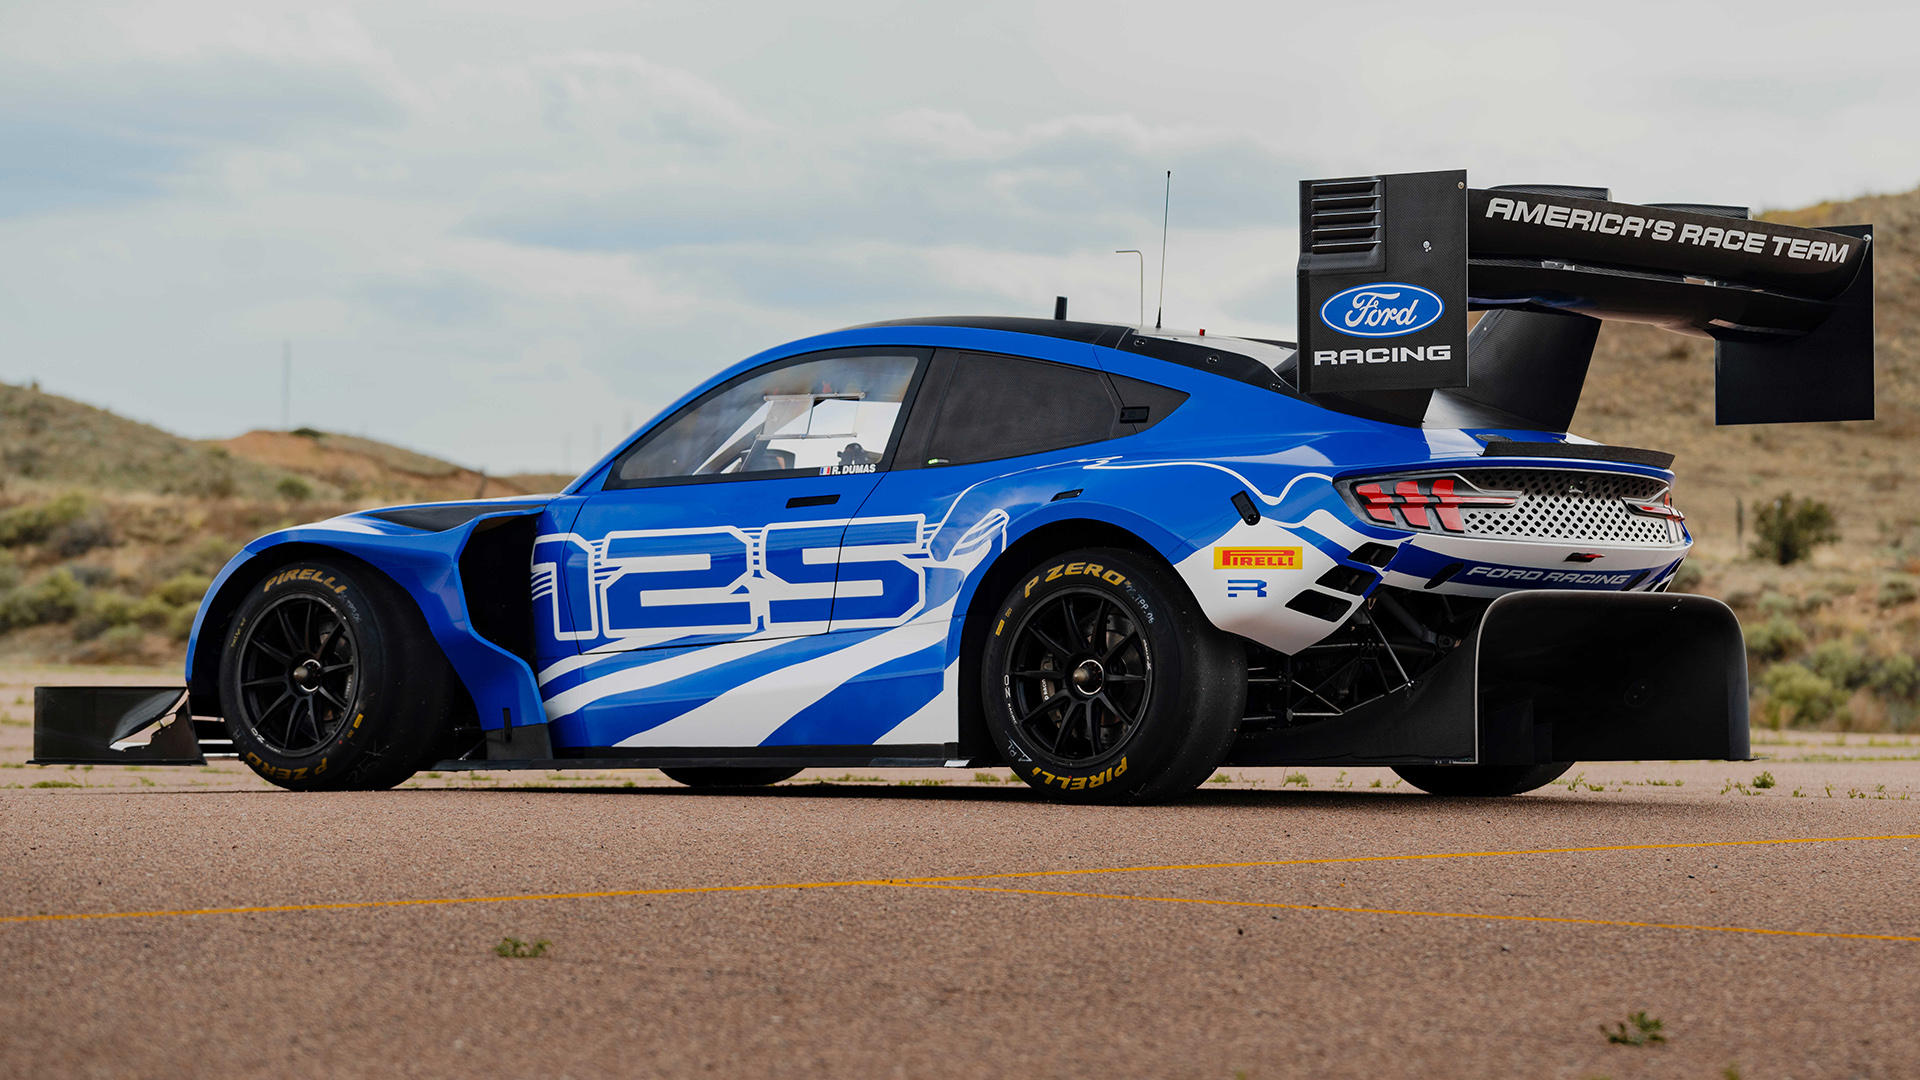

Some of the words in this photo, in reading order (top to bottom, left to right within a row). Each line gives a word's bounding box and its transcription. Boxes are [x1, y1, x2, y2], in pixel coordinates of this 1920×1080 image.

[1486, 197, 1676, 243] AMERICA'S
[1677, 223, 1768, 254] RACE
[1771, 235, 1850, 264] TEAM
[1345, 291, 1419, 327] Ford
[1313, 345, 1451, 366] RACING
[831, 465, 841, 475] R.
[842, 464, 875, 475] DUMAS
[1222, 550, 1295, 567] PIRELLI
[264, 568, 348, 594] PIRELLI
[1024, 575, 1040, 599] P
[1045, 562, 1126, 586] ZERO
[1467, 566, 1543, 582] FORD
[1546, 570, 1632, 585] RACING
[246, 751, 309, 781] ZERO
[314, 757, 328, 775] P
[1031, 756, 1128, 790] PIRELLI
